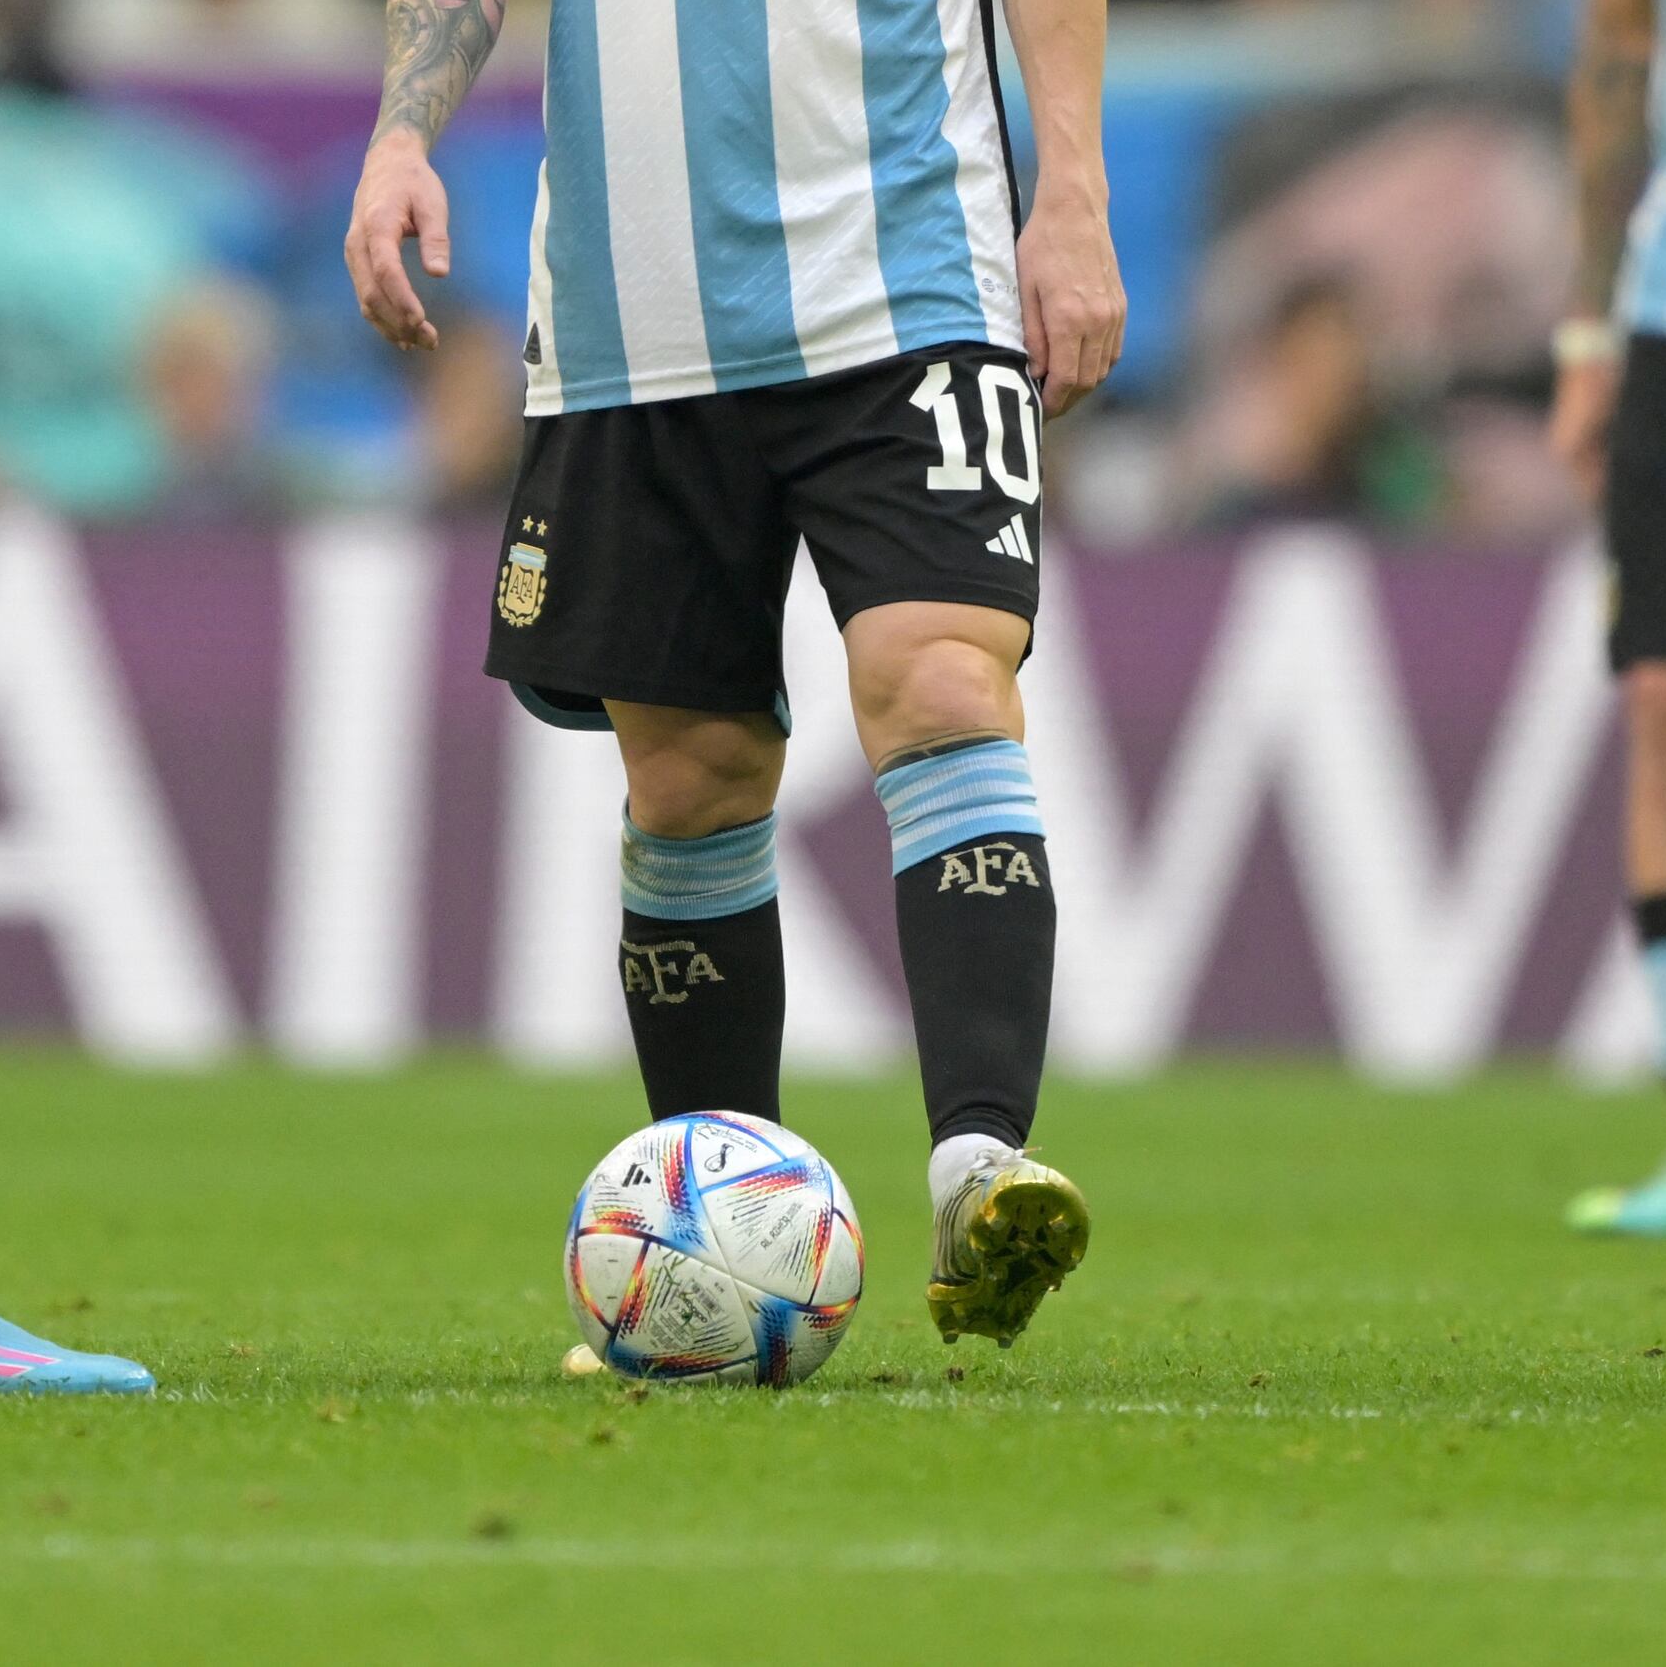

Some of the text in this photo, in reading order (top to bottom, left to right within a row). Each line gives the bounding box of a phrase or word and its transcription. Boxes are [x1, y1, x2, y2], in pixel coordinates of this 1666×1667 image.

[909, 361, 1040, 505] 10
[509, 565, 534, 604] AFA
[937, 842, 1041, 896] AFA
[621, 939, 725, 1004] AFA
